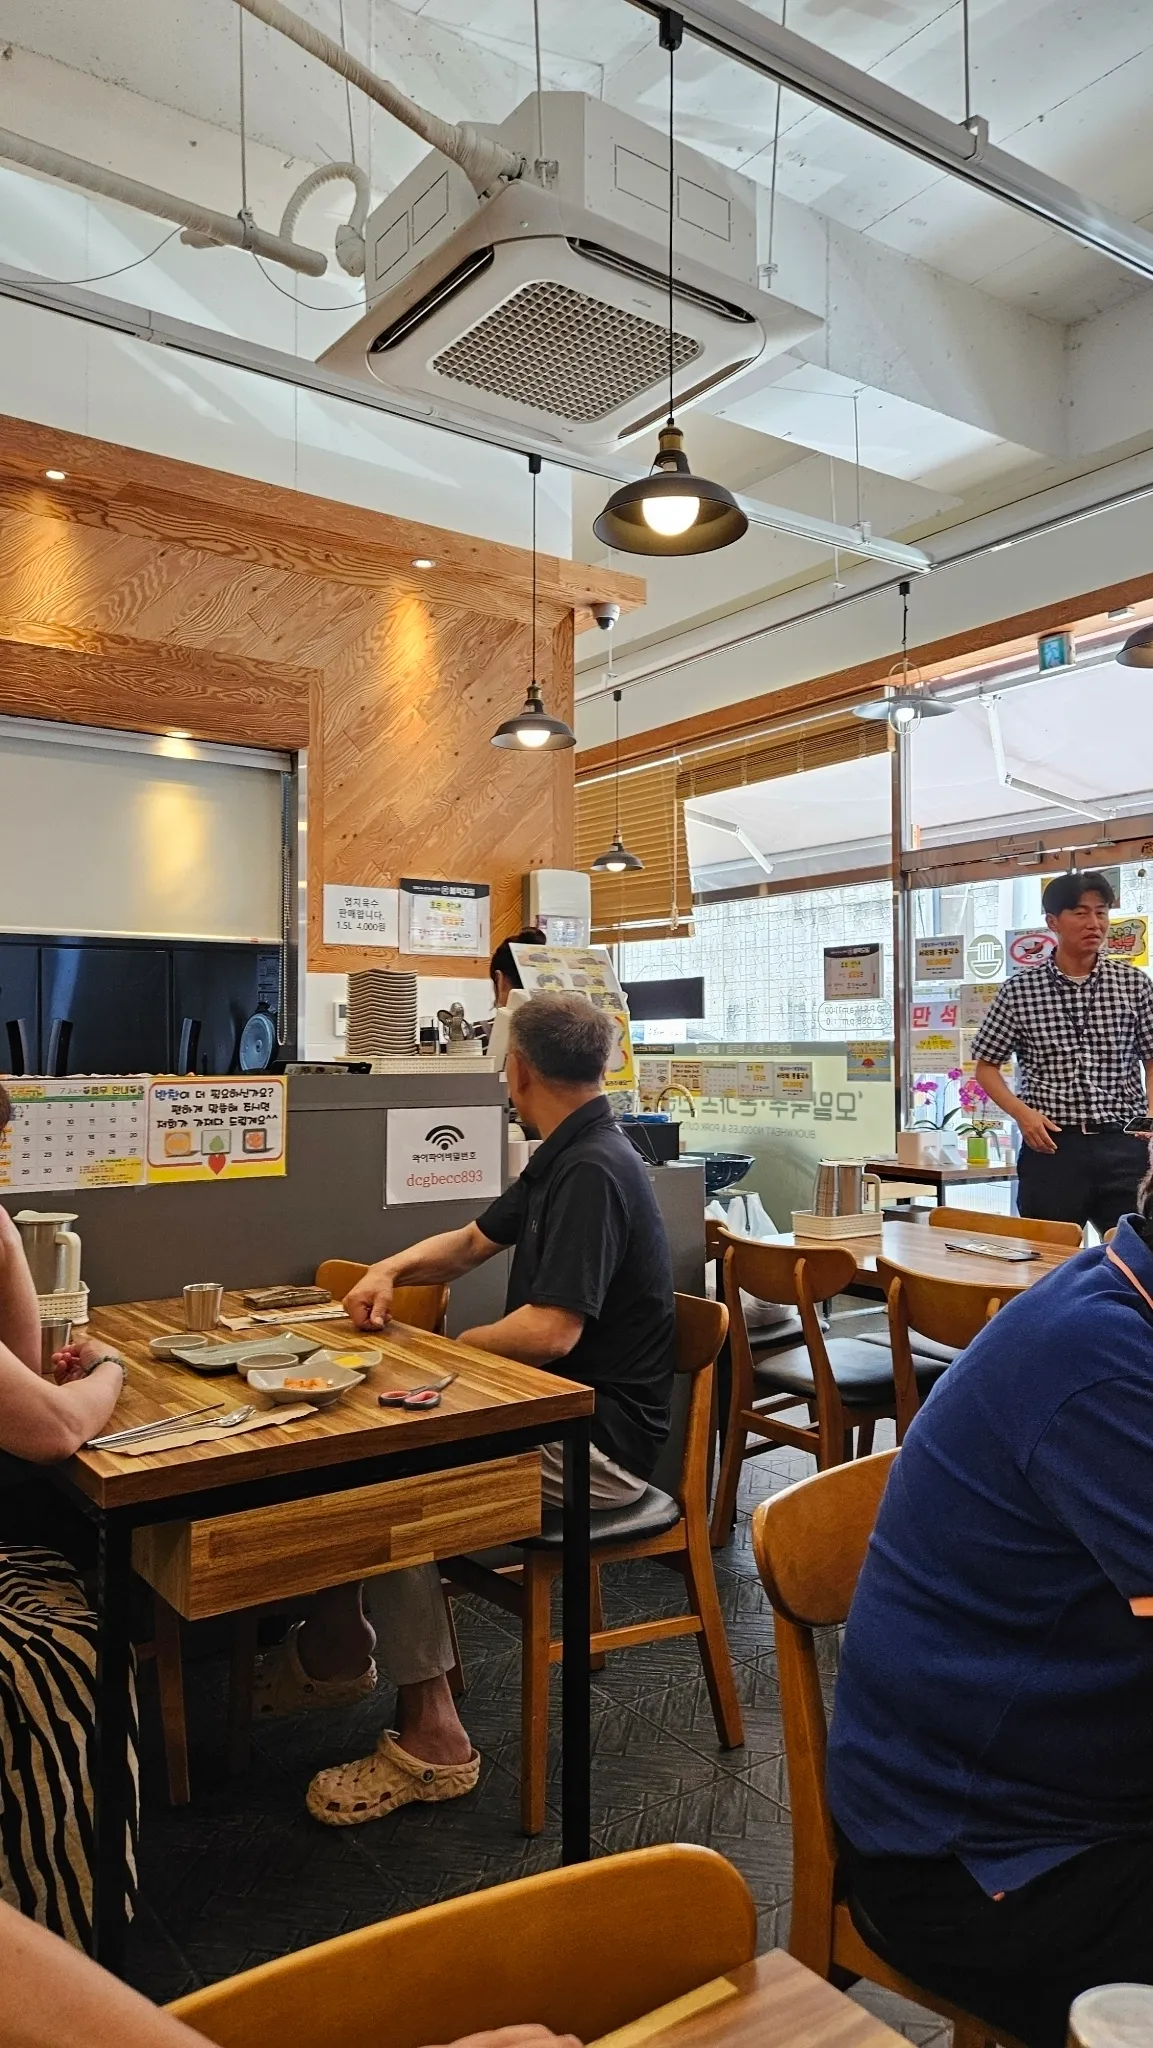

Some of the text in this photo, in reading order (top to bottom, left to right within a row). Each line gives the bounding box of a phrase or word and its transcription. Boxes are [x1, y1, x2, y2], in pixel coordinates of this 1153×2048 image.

[338, 909, 384, 920] 판매합니다.
[336, 922, 352, 930] 1.5L
[113, 1086, 129, 1094] 안내
[155, 1088, 274, 1101] 반찬이 더 필요하신가요?
[172, 1105, 202, 1115] 편하게
[157, 1119, 188, 1128] 저희가
[193, 1118, 224, 1126] 가져다
[406, 1169, 483, 1188] dcgbecc893
